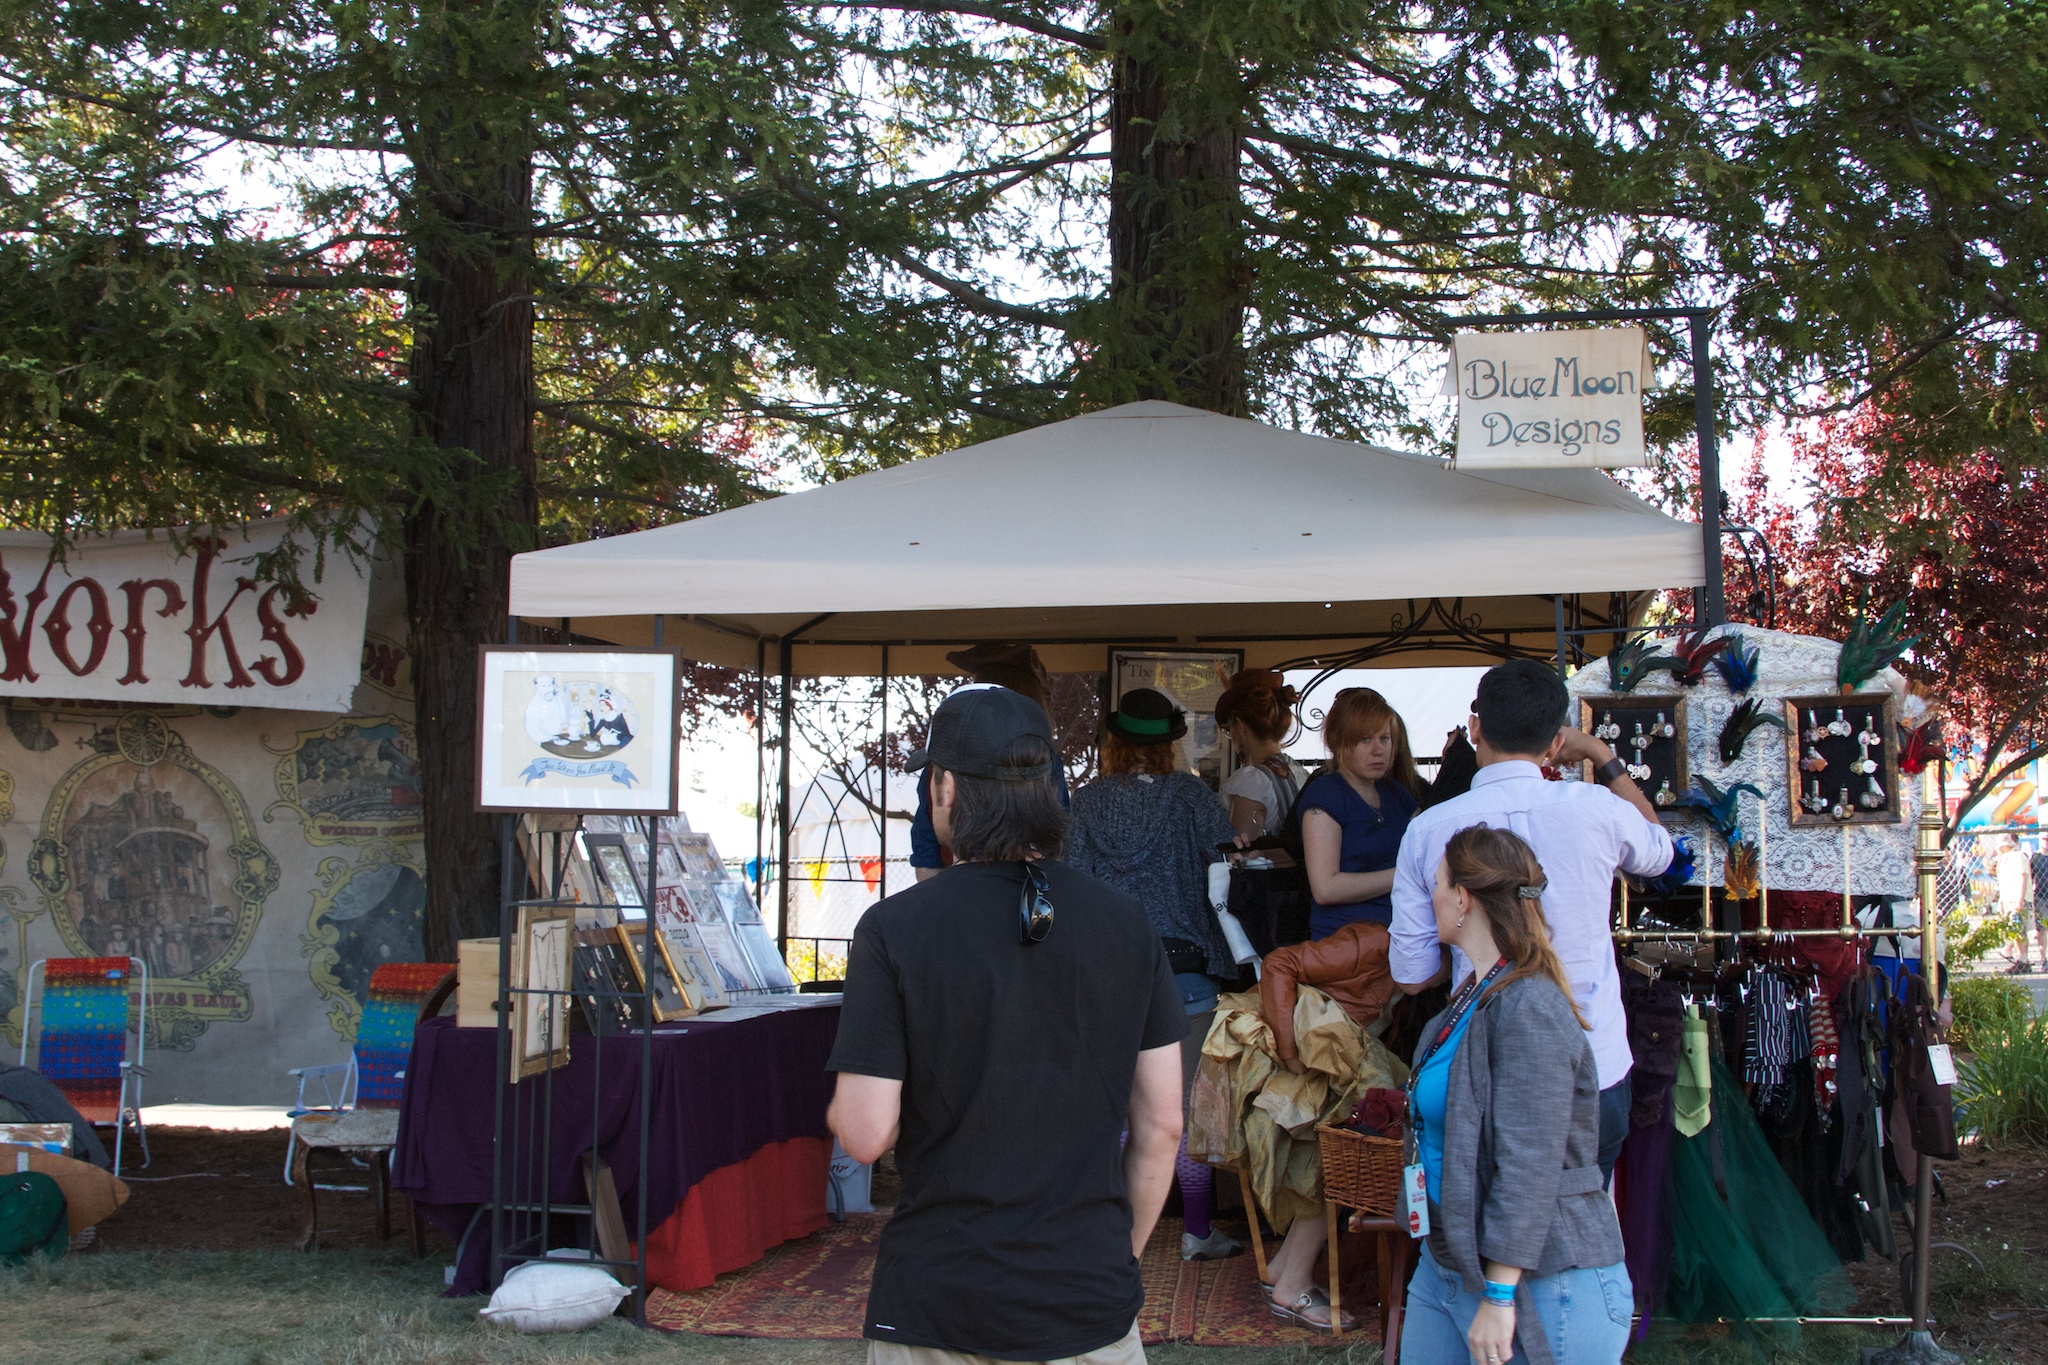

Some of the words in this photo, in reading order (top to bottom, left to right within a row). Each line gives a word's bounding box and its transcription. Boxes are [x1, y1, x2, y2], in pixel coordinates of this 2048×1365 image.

[1464, 358, 1546, 400] Blue
[1548, 356, 1637, 398] Moon
[1481, 411, 1622, 457] Designs
[556, 761, 575, 774] When
[575, 764, 587, 777] You
[588, 763, 608, 774] Need
[191, 993, 242, 1009] HAUL
